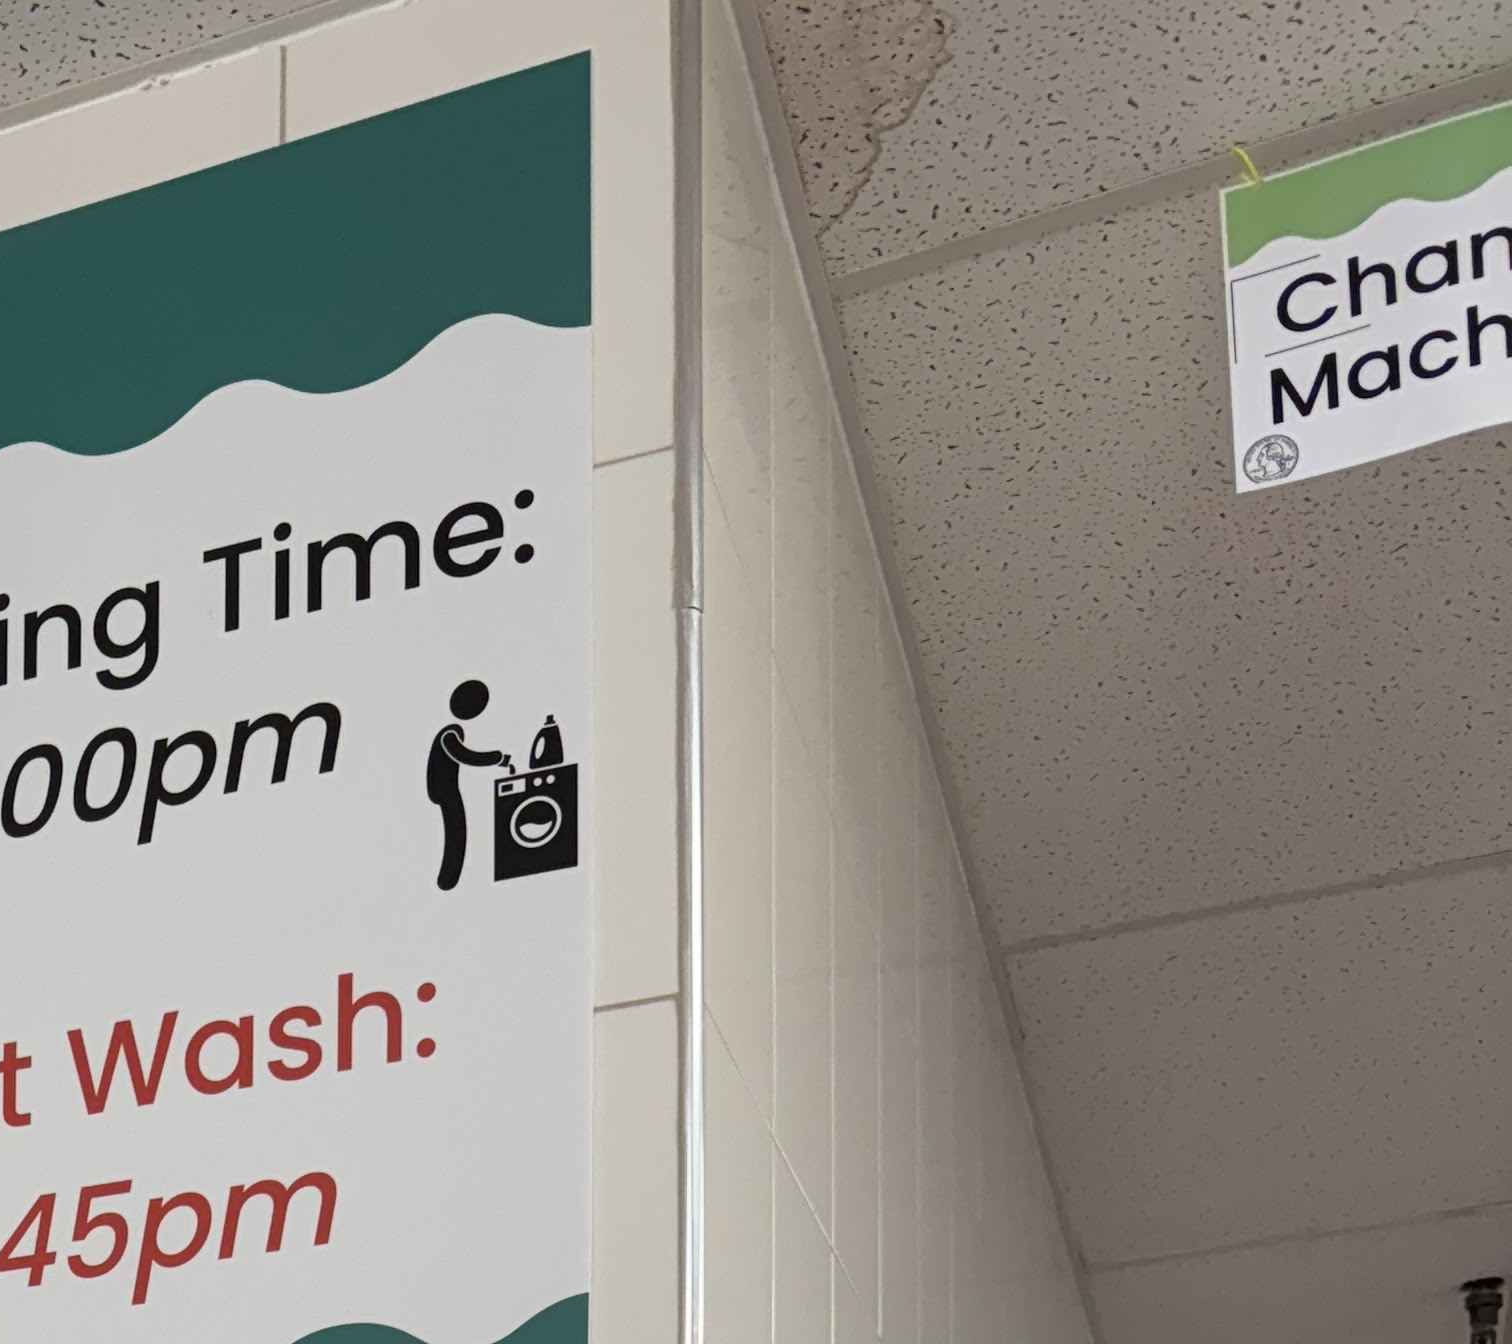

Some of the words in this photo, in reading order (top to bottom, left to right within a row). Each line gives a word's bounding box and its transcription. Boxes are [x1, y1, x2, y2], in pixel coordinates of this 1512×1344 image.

[1276, 226, 1512, 333] Chan
[1270, 305, 1512, 425] Mach
[202, 488, 536, 634] Time:
[66, 972, 437, 1116] Wash:
